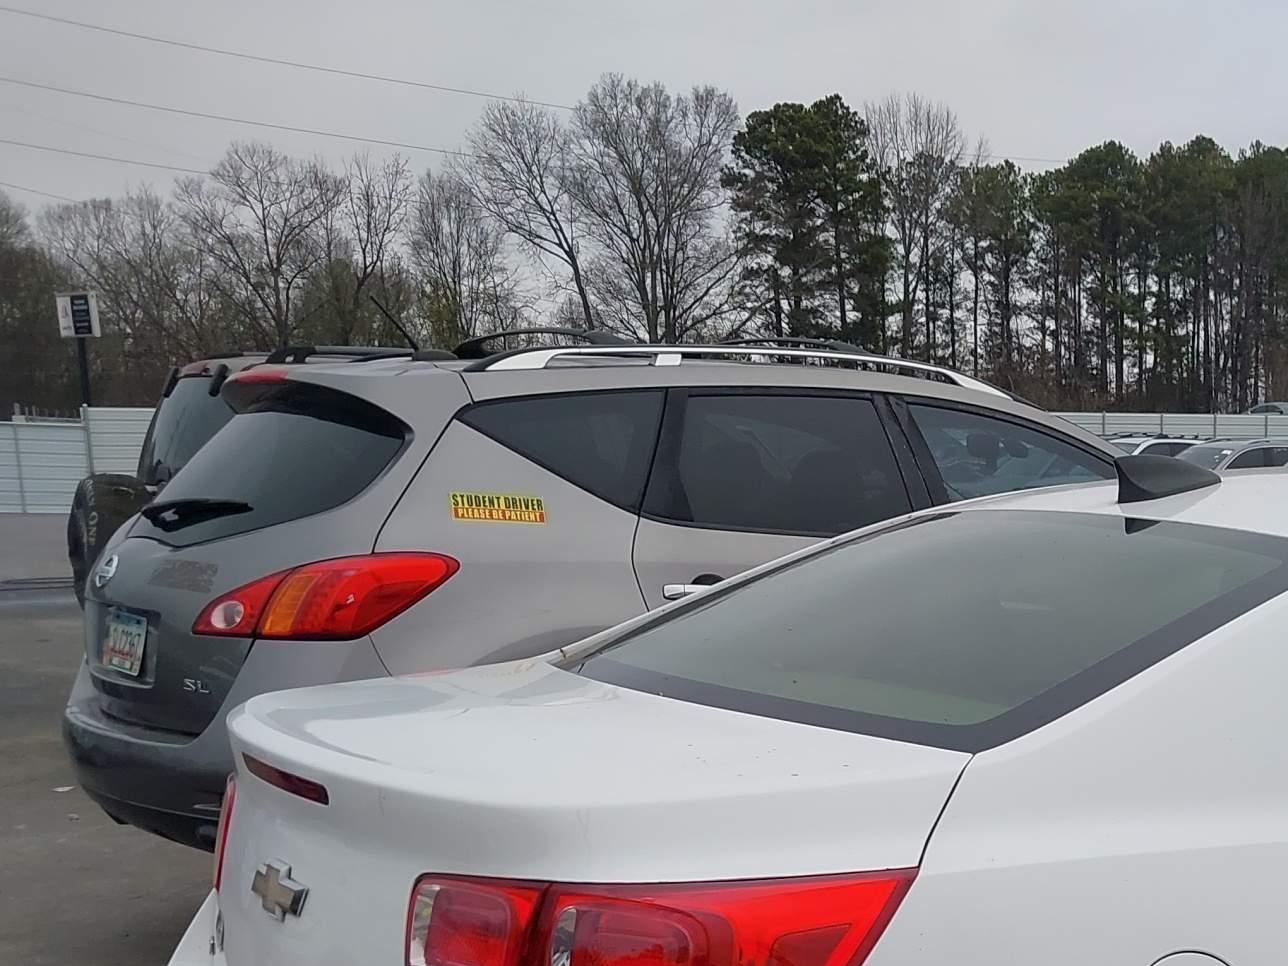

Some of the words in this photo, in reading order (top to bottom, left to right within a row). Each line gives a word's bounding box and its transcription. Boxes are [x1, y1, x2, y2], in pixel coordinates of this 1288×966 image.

[451, 493, 501, 508] STUDENT
[504, 496, 544, 511] DRIVER
[458, 507, 490, 519] PLEASE
[504, 510, 541, 522] PATIENT
[183, 678, 210, 694] SL
